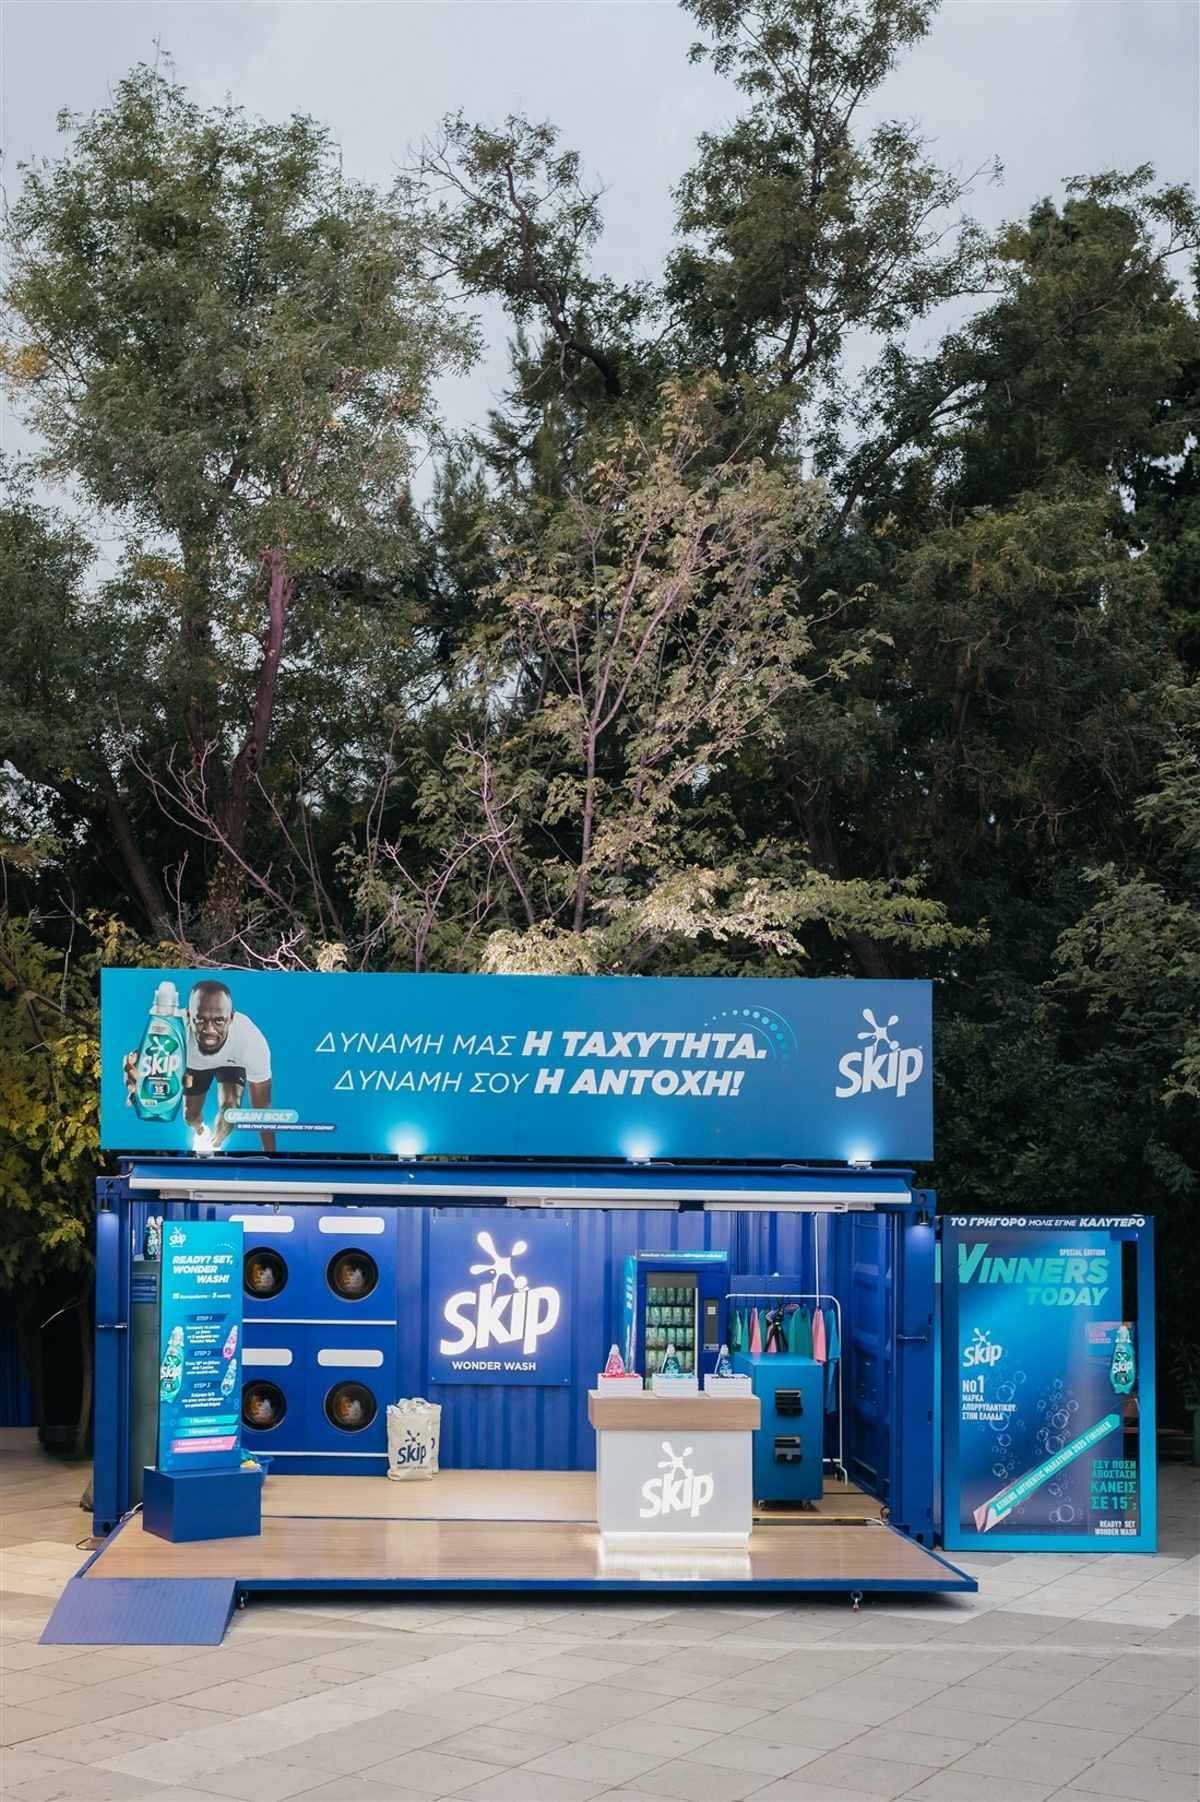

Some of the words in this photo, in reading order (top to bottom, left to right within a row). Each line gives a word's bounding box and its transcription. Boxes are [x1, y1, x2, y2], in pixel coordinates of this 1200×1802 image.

[315, 1031, 444, 1055] ΔΥΝΑΜΗ
[452, 1032, 517, 1056] ΜΑΣ
[521, 1030, 551, 1057] Η
[562, 1030, 767, 1060] ΤΑΧΥΤΗΤΑ.
[333, 1071, 463, 1092] ΔΥΝΑΜΗ
[469, 1072, 530, 1095] ΣΟΥ
[534, 1068, 565, 1095] Η
[569, 1069, 745, 1097] ΑΝΤΟΧΗ!
[950, 1217, 967, 1227] ΤΟ
[969, 1217, 1027, 1228] ΓΡΗΓΟΡΟ
[1079, 1217, 1145, 1228] ΚΑΛΥΤΕΡΟ
[172, 1255, 211, 1265] READY?
[173, 1265, 218, 1274] WONDER
[197, 1275, 230, 1284] WASH!
[1026, 1287, 1109, 1306] TODAY
[452, 1360, 501, 1371] WONDER
[504, 1360, 537, 1371] WASH
[1090, 1481, 1137, 1494] ΚΑΝΕΙΣ
[1091, 1496, 1109, 1510] ΣΕ
